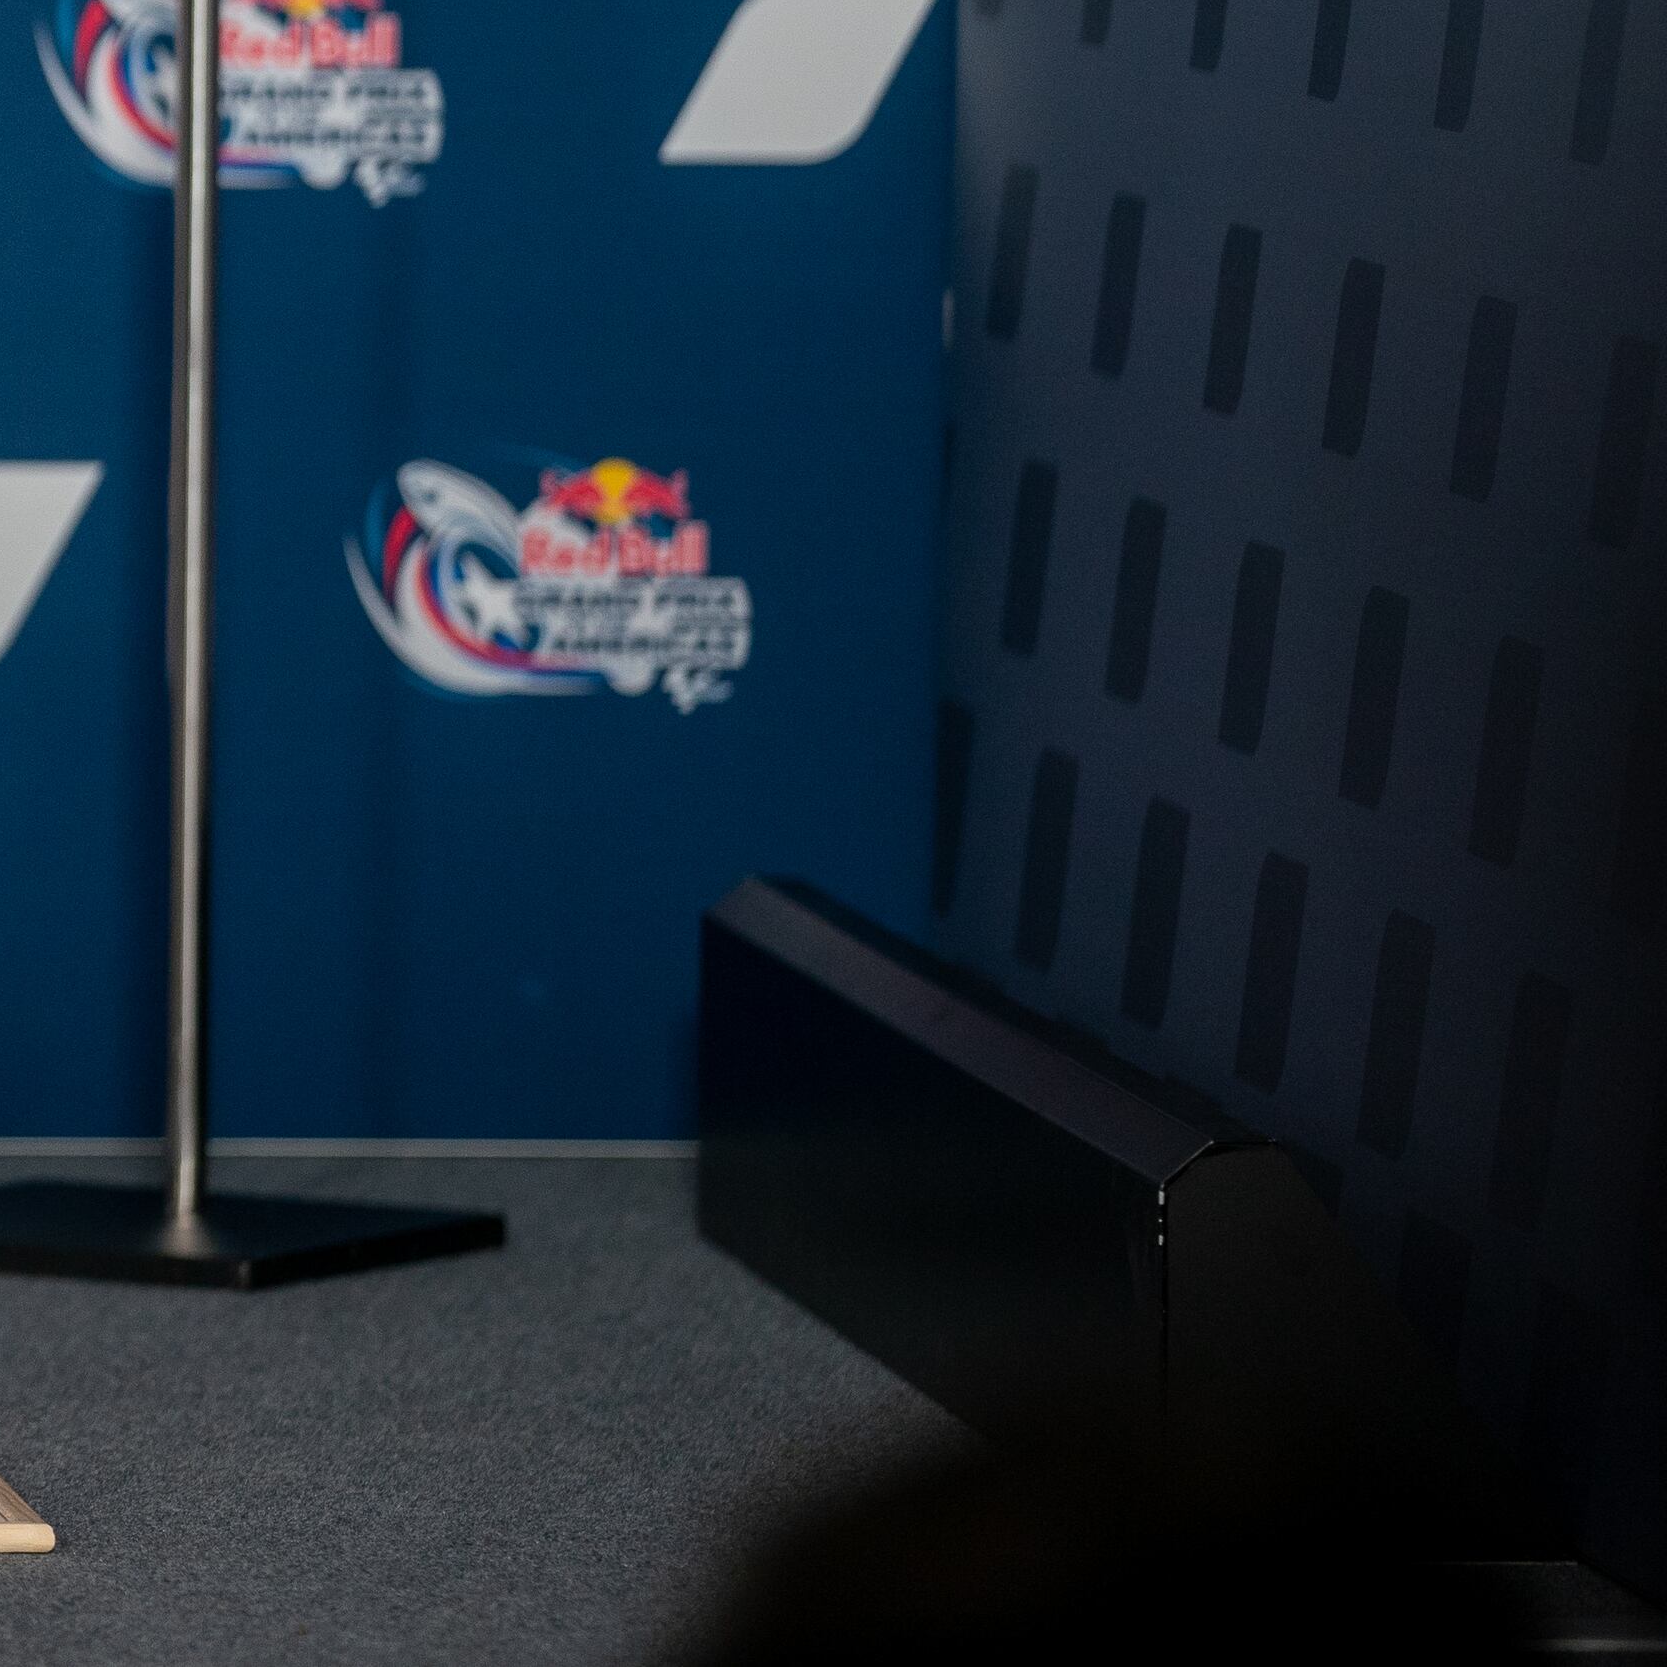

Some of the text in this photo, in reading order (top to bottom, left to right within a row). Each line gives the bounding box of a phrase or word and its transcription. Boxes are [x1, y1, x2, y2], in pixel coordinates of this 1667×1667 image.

[219, 13, 402, 70] Red Bull
[521, 520, 711, 575] Red Bull
